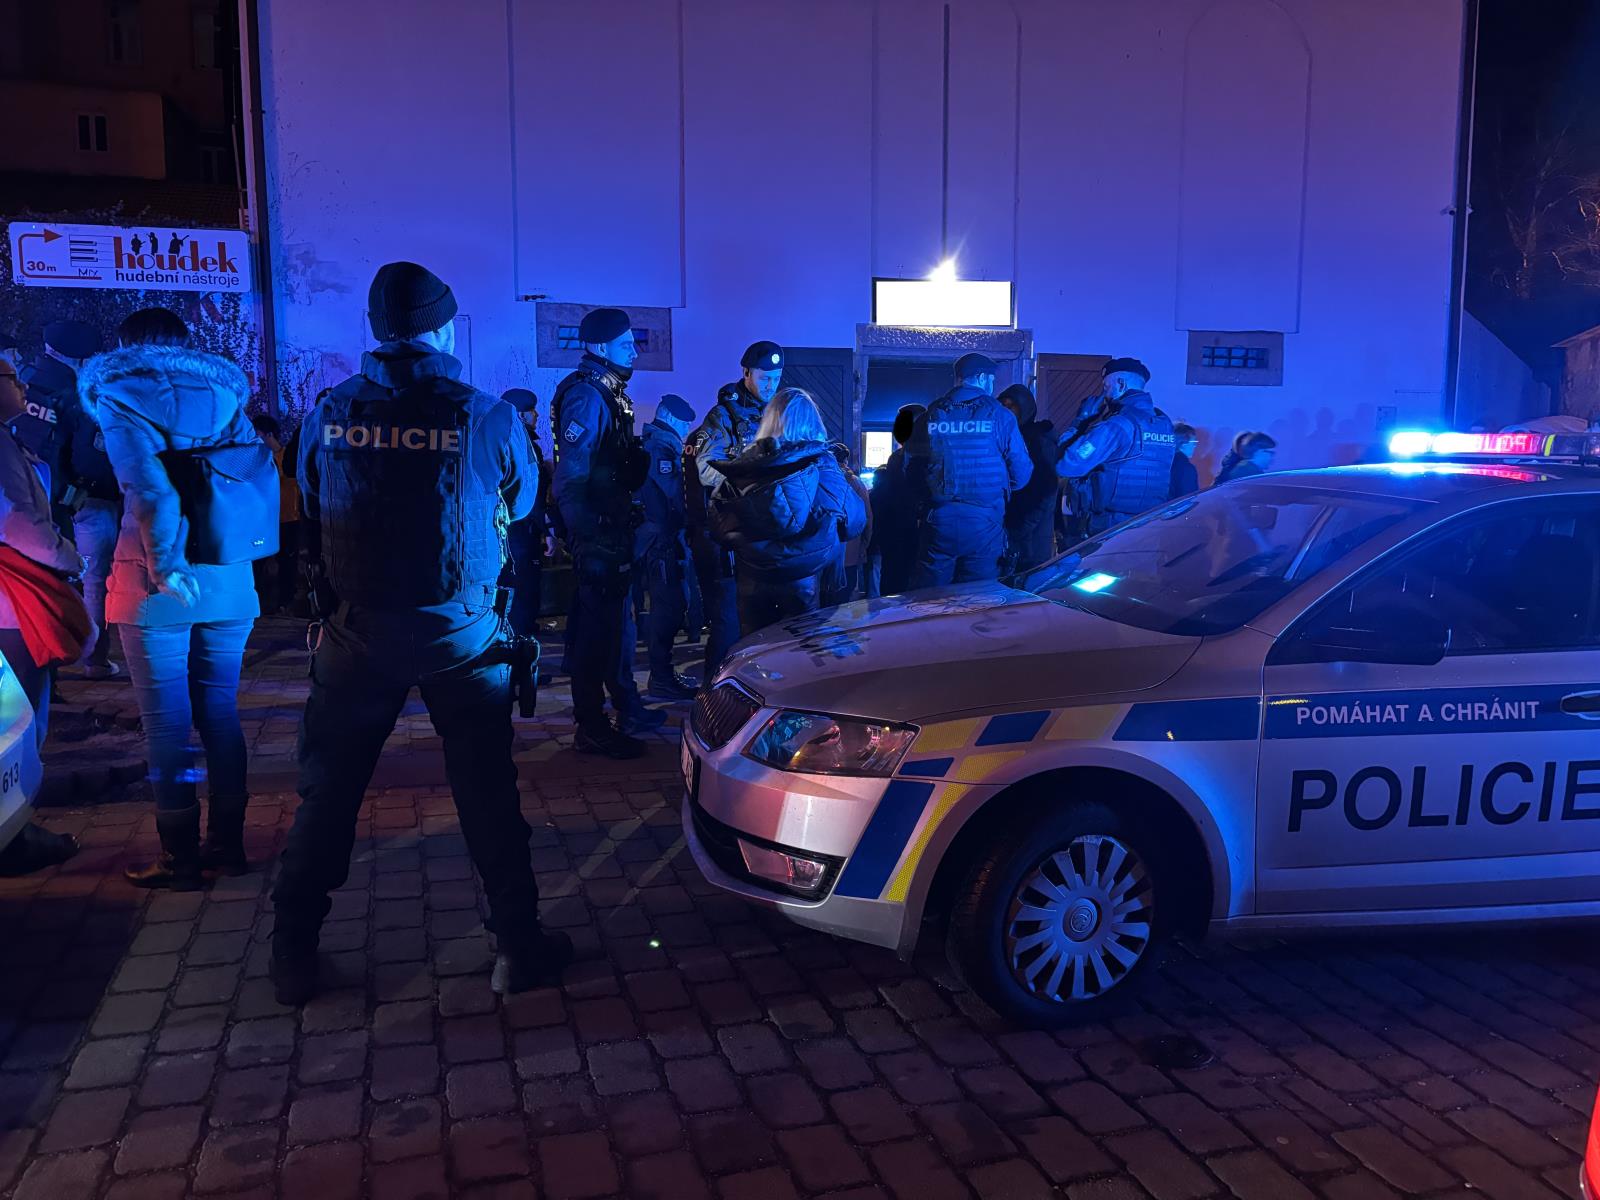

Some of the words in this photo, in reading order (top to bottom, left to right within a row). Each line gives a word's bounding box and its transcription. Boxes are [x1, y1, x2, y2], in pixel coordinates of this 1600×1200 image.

[27, 260, 45, 271] 30
[113, 236, 238, 273] houdek
[115, 269, 180, 283] hudební
[183, 272, 240, 288] nástroje
[323, 424, 460, 452] POLICIE
[927, 420, 993, 434] POLICIE
[1143, 432, 1176, 443] POLICIE
[1296, 701, 1409, 725] POMÁHAT
[1417, 704, 1434, 722] A
[1440, 697, 1540, 722] CHRÁNIT
[2, 762, 19, 793] 613
[1287, 759, 1600, 833] POLICIE
